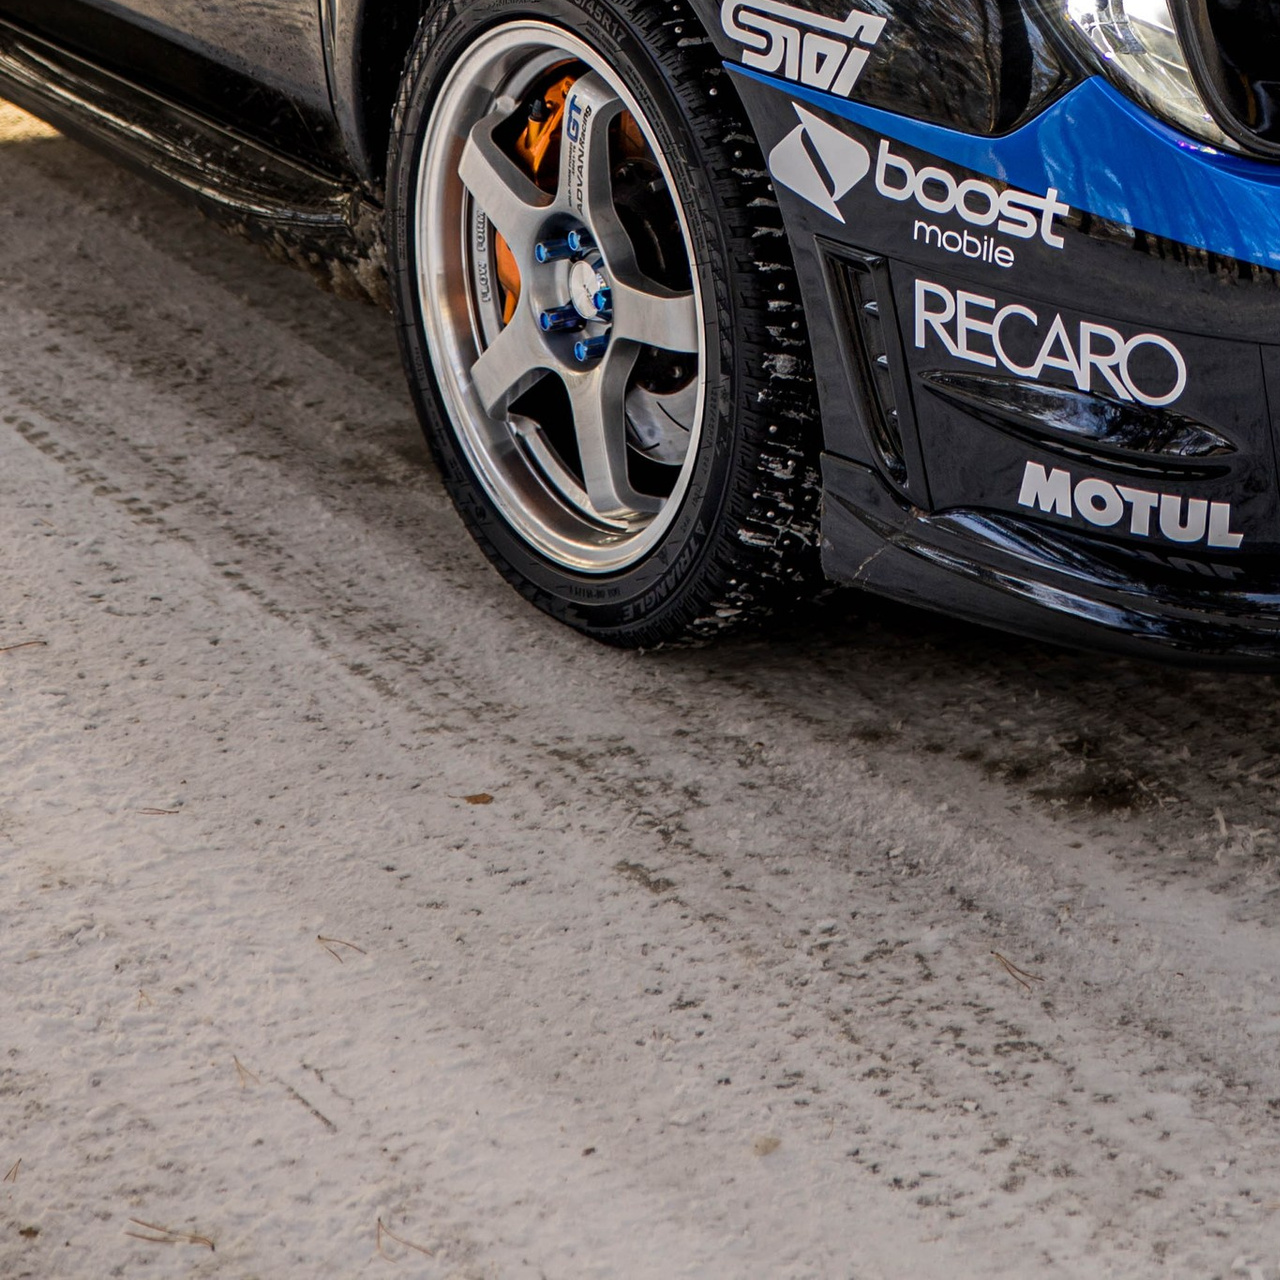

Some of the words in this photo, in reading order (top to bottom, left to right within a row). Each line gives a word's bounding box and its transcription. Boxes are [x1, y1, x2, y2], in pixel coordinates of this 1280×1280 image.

[567, 94, 582, 143] GT
[579, 105, 592, 150] Racing
[577, 149, 585, 216] ADVAN
[875, 139, 1070, 249] boost
[914, 219, 1015, 268] mobile
[914, 278, 1187, 406] RECARO
[1018, 460, 1244, 548] MOTUL
[622, 537, 700, 621] TRIANGLE
